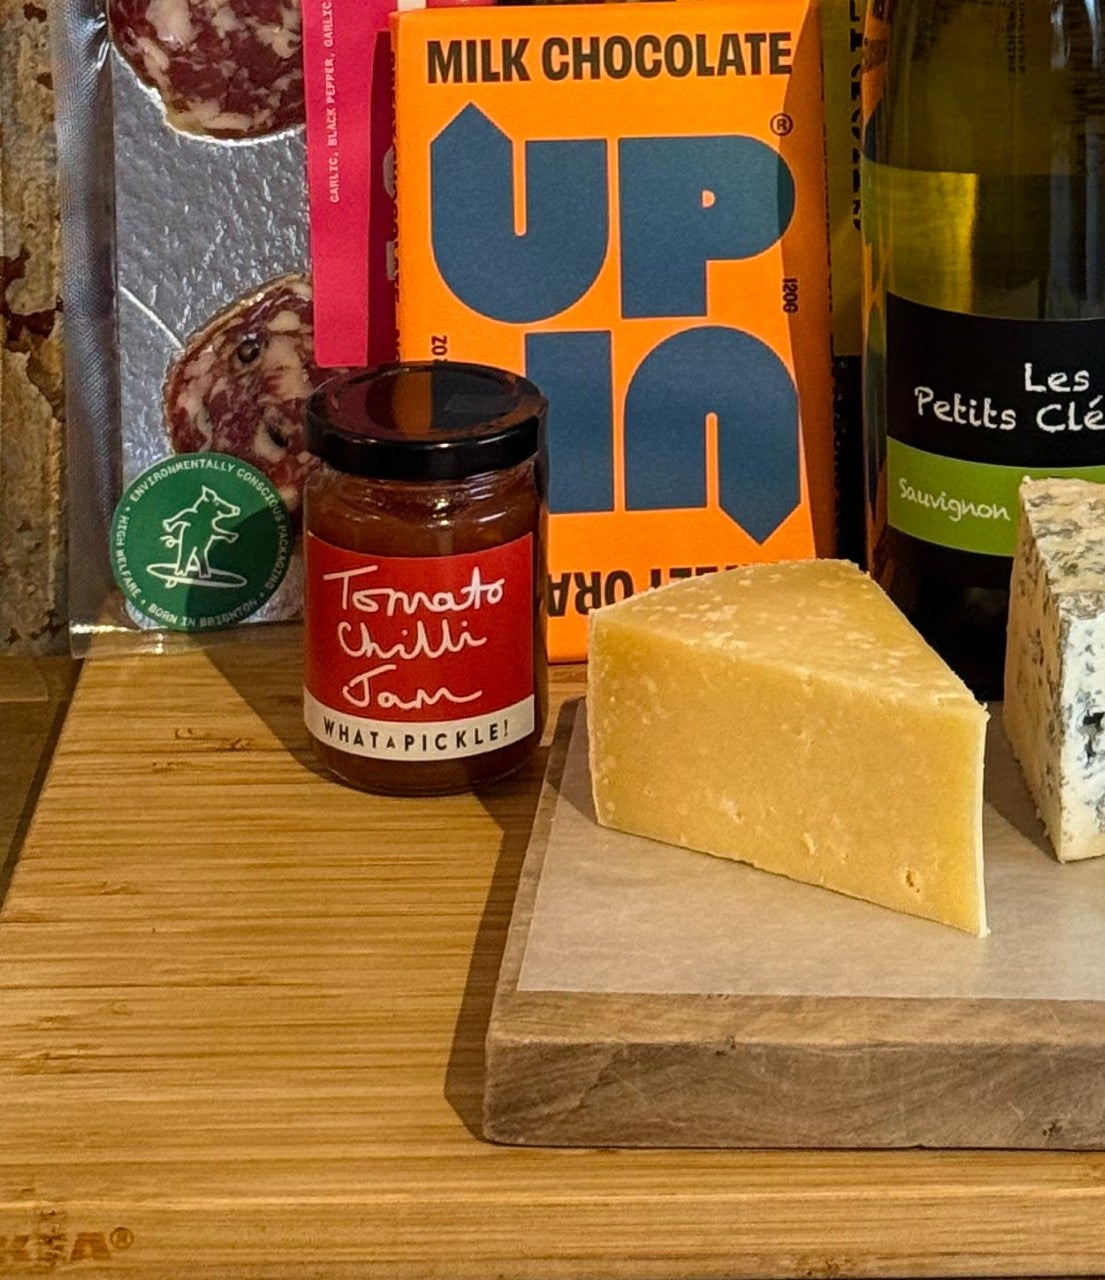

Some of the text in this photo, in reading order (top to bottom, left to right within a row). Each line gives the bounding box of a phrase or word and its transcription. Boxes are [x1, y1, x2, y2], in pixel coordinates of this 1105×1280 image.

[427, 31, 793, 84] MILK CHOCOLATE
[326, 107, 338, 147] BLACK
[430, 101, 796, 324] UP
[1023, 362, 1091, 393] Les
[914, 386, 1017, 430] Petits
[525, 325, 802, 546] IN
[129, 458, 236, 503] ENVIRONMENTALLY
[236, 467, 283, 522] CONSCIOUS
[899, 477, 1012, 523] Sauvignon
[115, 514, 143, 599] HIGH WELFARE
[147, 599, 259, 628] BORN IN BRIGHTON
[322, 564, 506, 617] Tomato
[337, 618, 488, 660] Chilli
[341, 663, 484, 711] Jam
